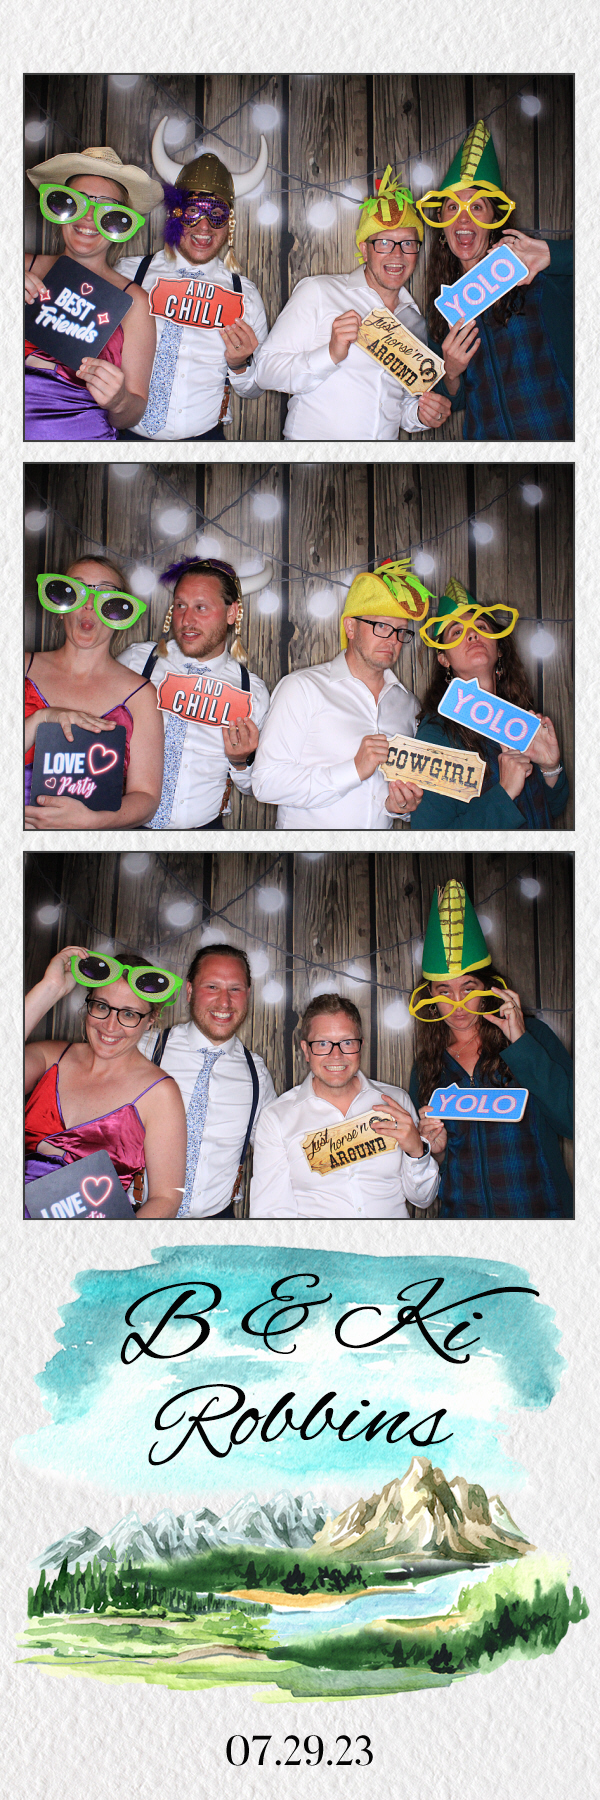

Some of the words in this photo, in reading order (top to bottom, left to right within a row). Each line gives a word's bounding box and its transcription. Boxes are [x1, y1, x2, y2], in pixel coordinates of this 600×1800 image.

[54, 287, 96, 321] BEST
[186, 280, 216, 300] AND
[444, 258, 515, 318] YOLO
[34, 304, 99, 344] Friends
[164, 295, 224, 328] CHILL
[366, 338, 419, 387] AROUND
[381, 332, 424, 362] horse'n
[194, 677, 224, 698] AND
[172, 690, 231, 726] CHILL
[453, 687, 529, 742] YOLO
[43, 752, 86, 775] LOVE
[385, 746, 478, 789] COWGIRL
[57, 776, 97, 799] Party
[439, 1094, 517, 1114] YOLO
[329, 1122, 369, 1152] horse'n
[329, 1136, 387, 1169] AROUND
